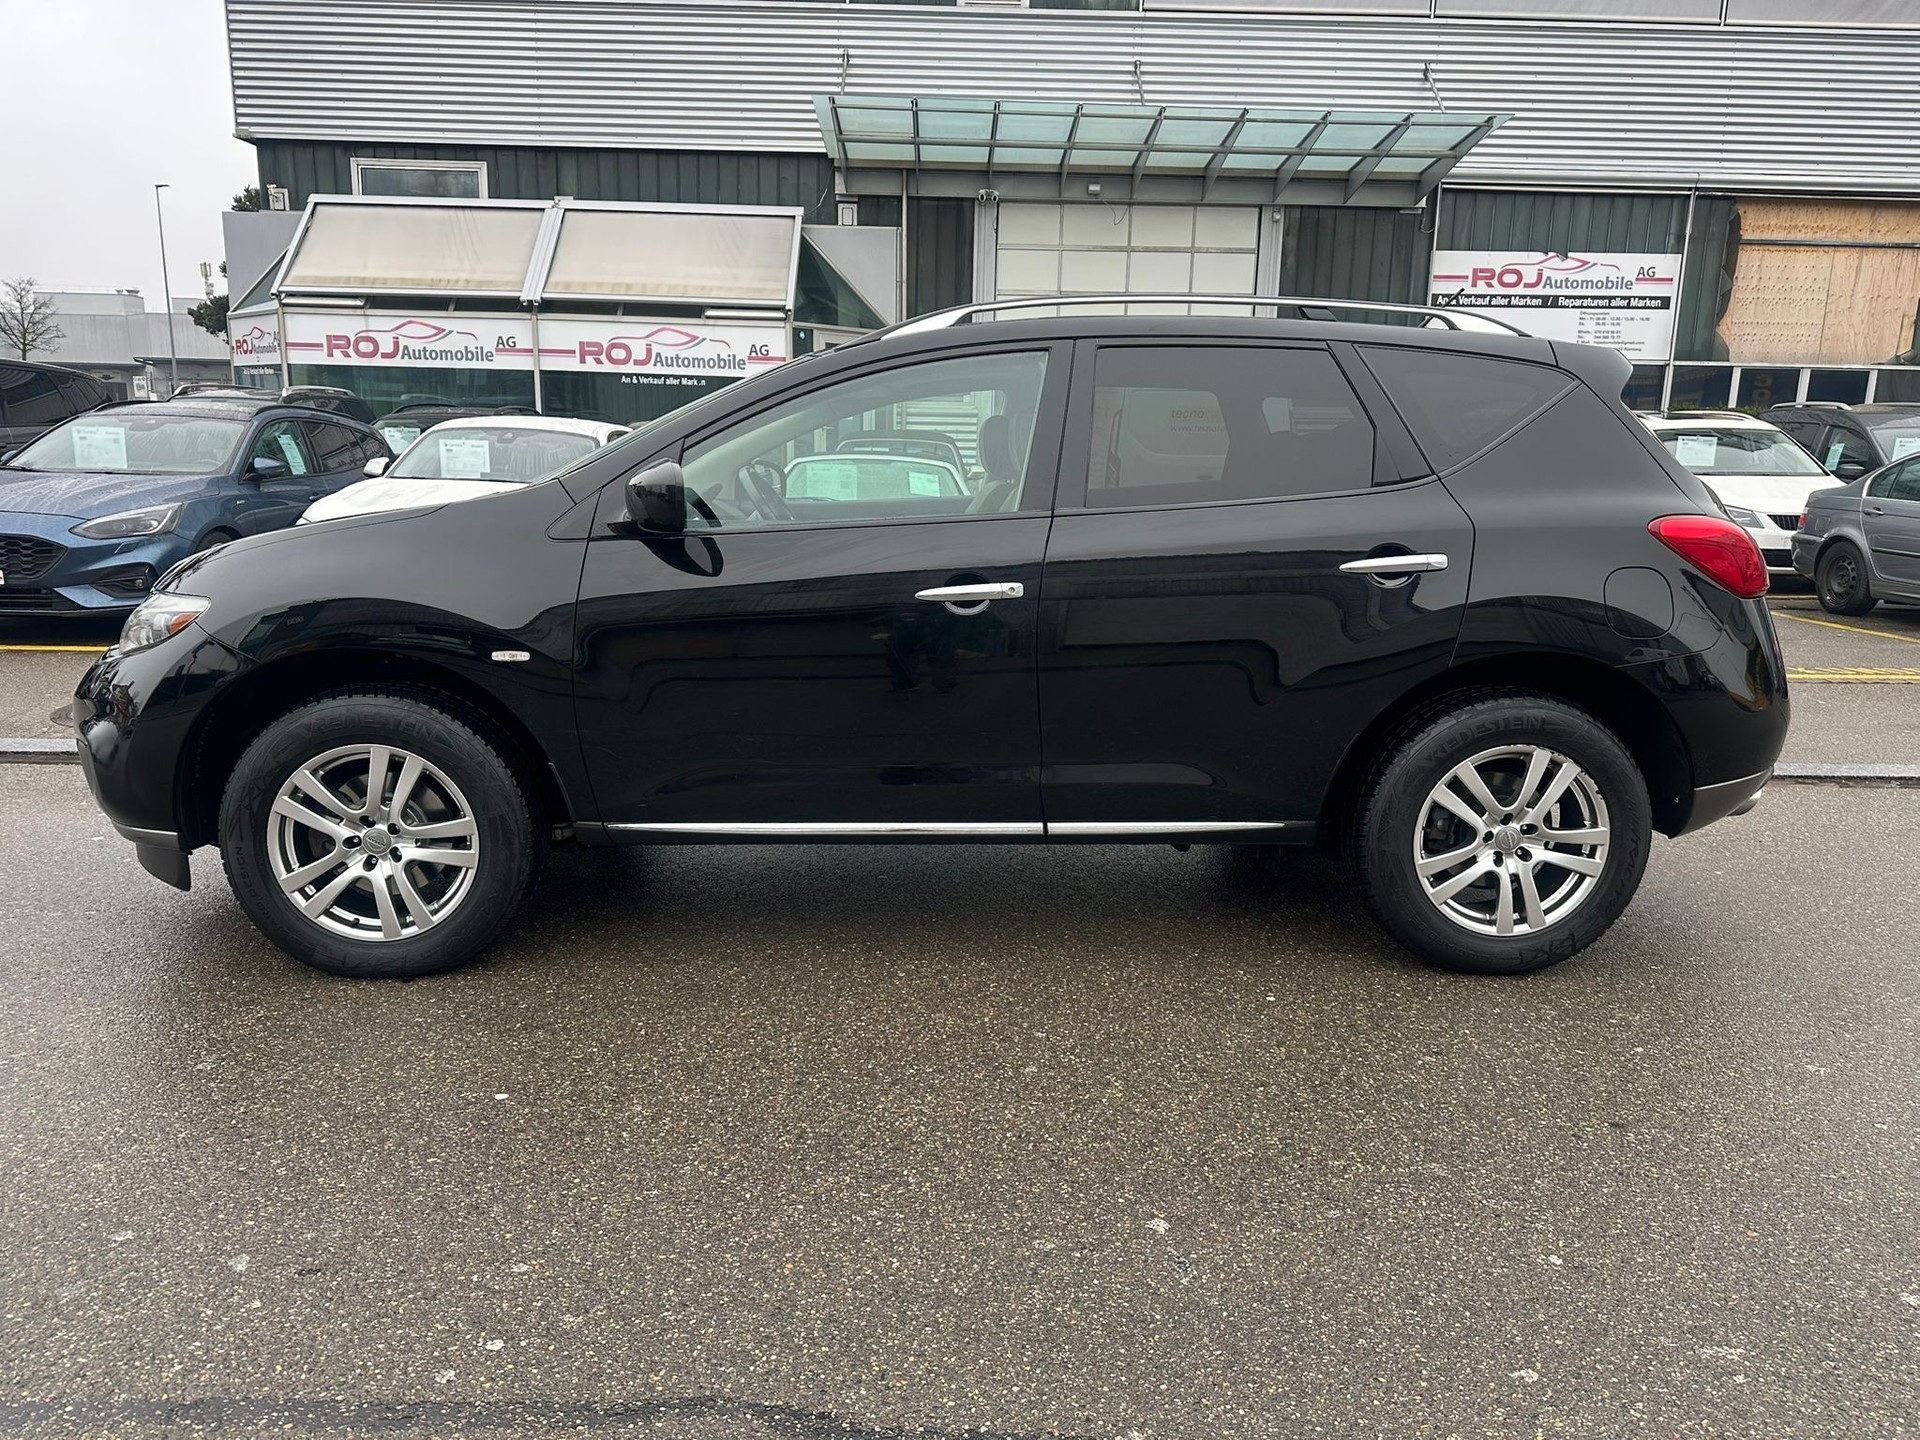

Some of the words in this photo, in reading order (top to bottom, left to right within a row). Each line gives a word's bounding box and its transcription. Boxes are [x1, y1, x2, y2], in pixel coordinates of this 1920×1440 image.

[1471, 267, 1544, 289] ROJ
[1542, 275, 1634, 290] Automobile
[1636, 266, 1657, 278] AG
[1458, 295, 1490, 305] Verkauf
[1491, 296, 1510, 306] aller
[1510, 296, 1542, 306] Marken
[1558, 296, 1609, 308] Reparaturen
[1610, 297, 1629, 307] aller
[1630, 298, 1661, 307] Marken
[235, 338, 254, 355] ROJ
[325, 334, 400, 359] ROJ
[401, 344, 494, 362] Automobile
[496, 336, 517, 348] AG
[579, 341, 653, 366] ROJ
[653, 351, 746, 371] Automobile
[749, 344, 769, 356] AG
[621, 375, 631, 384] An
[638, 375, 665, 385] Verkauf
[665, 376, 680, 386] aller
[681, 377, 706, 386] Markn
